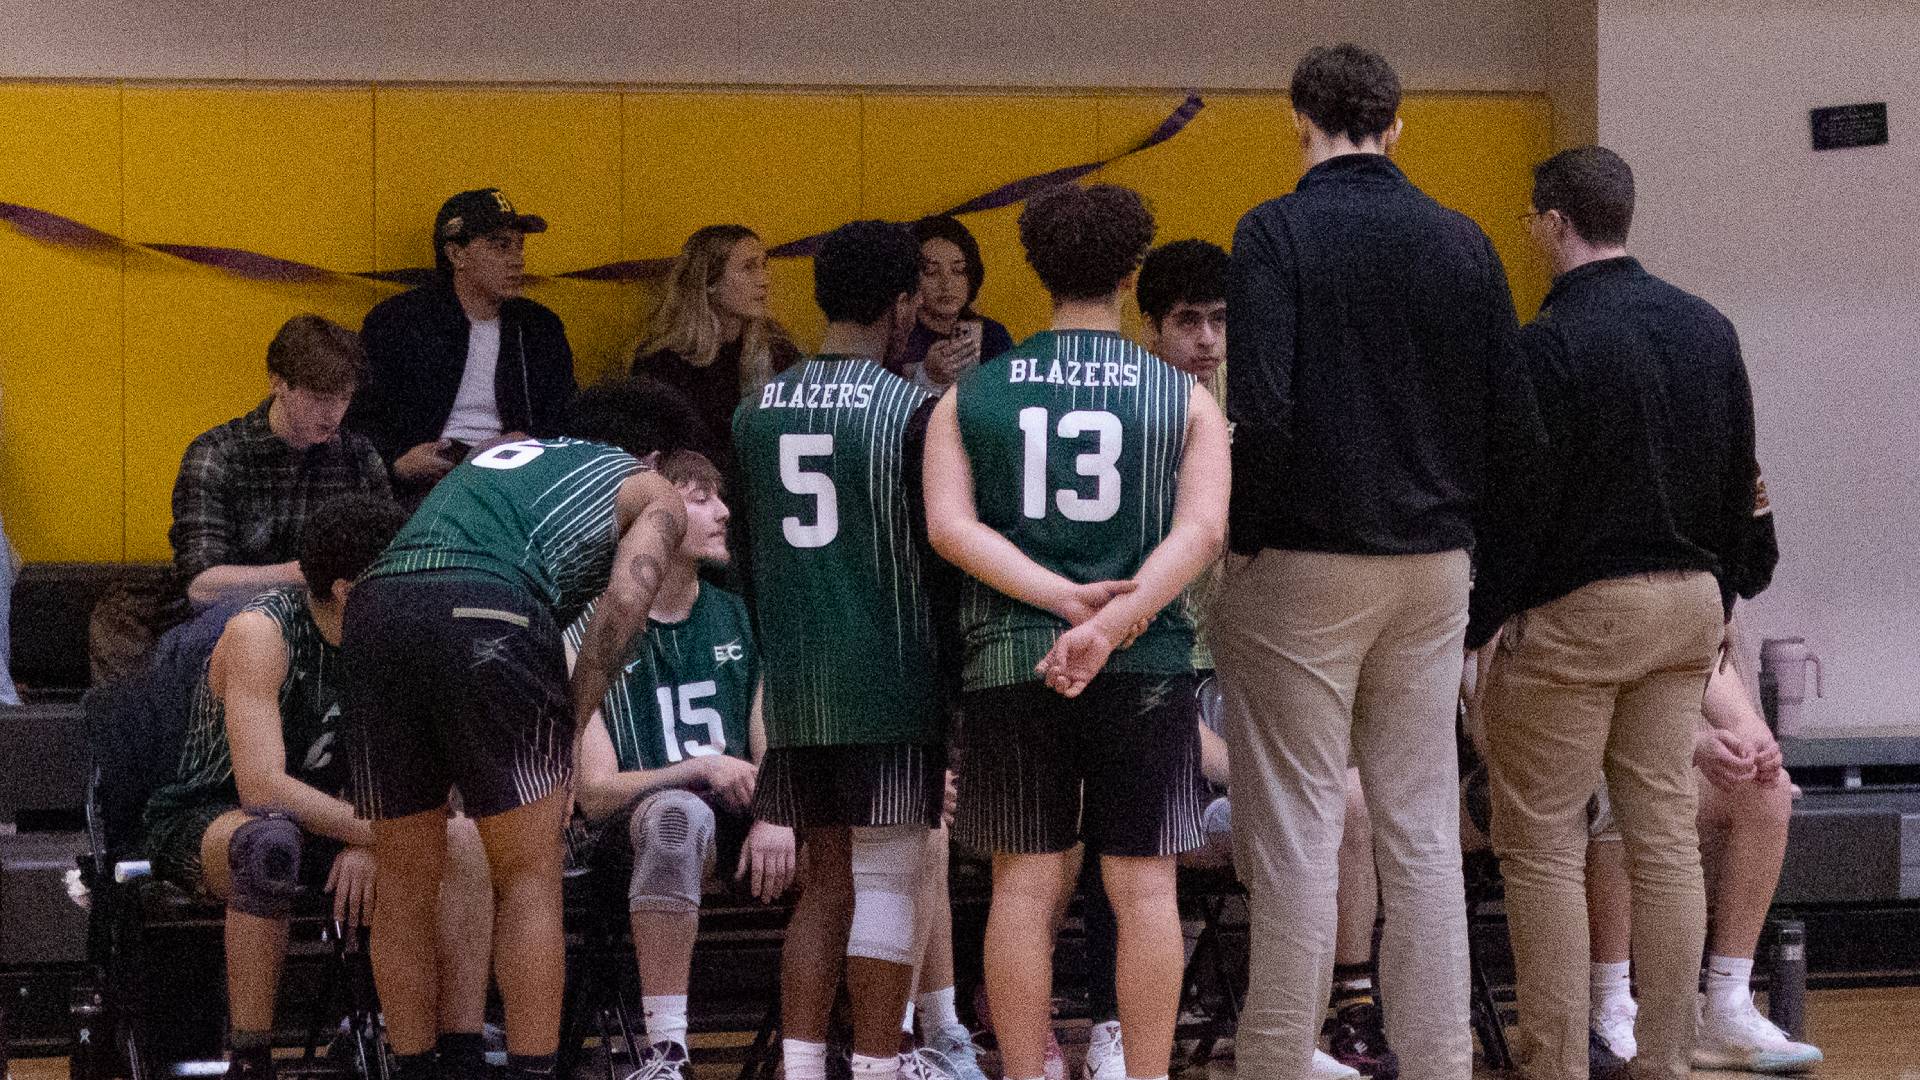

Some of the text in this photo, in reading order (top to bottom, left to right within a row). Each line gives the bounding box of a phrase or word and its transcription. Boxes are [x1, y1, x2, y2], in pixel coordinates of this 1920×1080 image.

[759, 382, 873, 409] BLAZERS
[1009, 358, 1138, 387] BLAZERS
[779, 433, 839, 548] 5
[1019, 406, 1123, 522] 13
[713, 644, 743, 661] EC
[656, 680, 726, 762] 15
